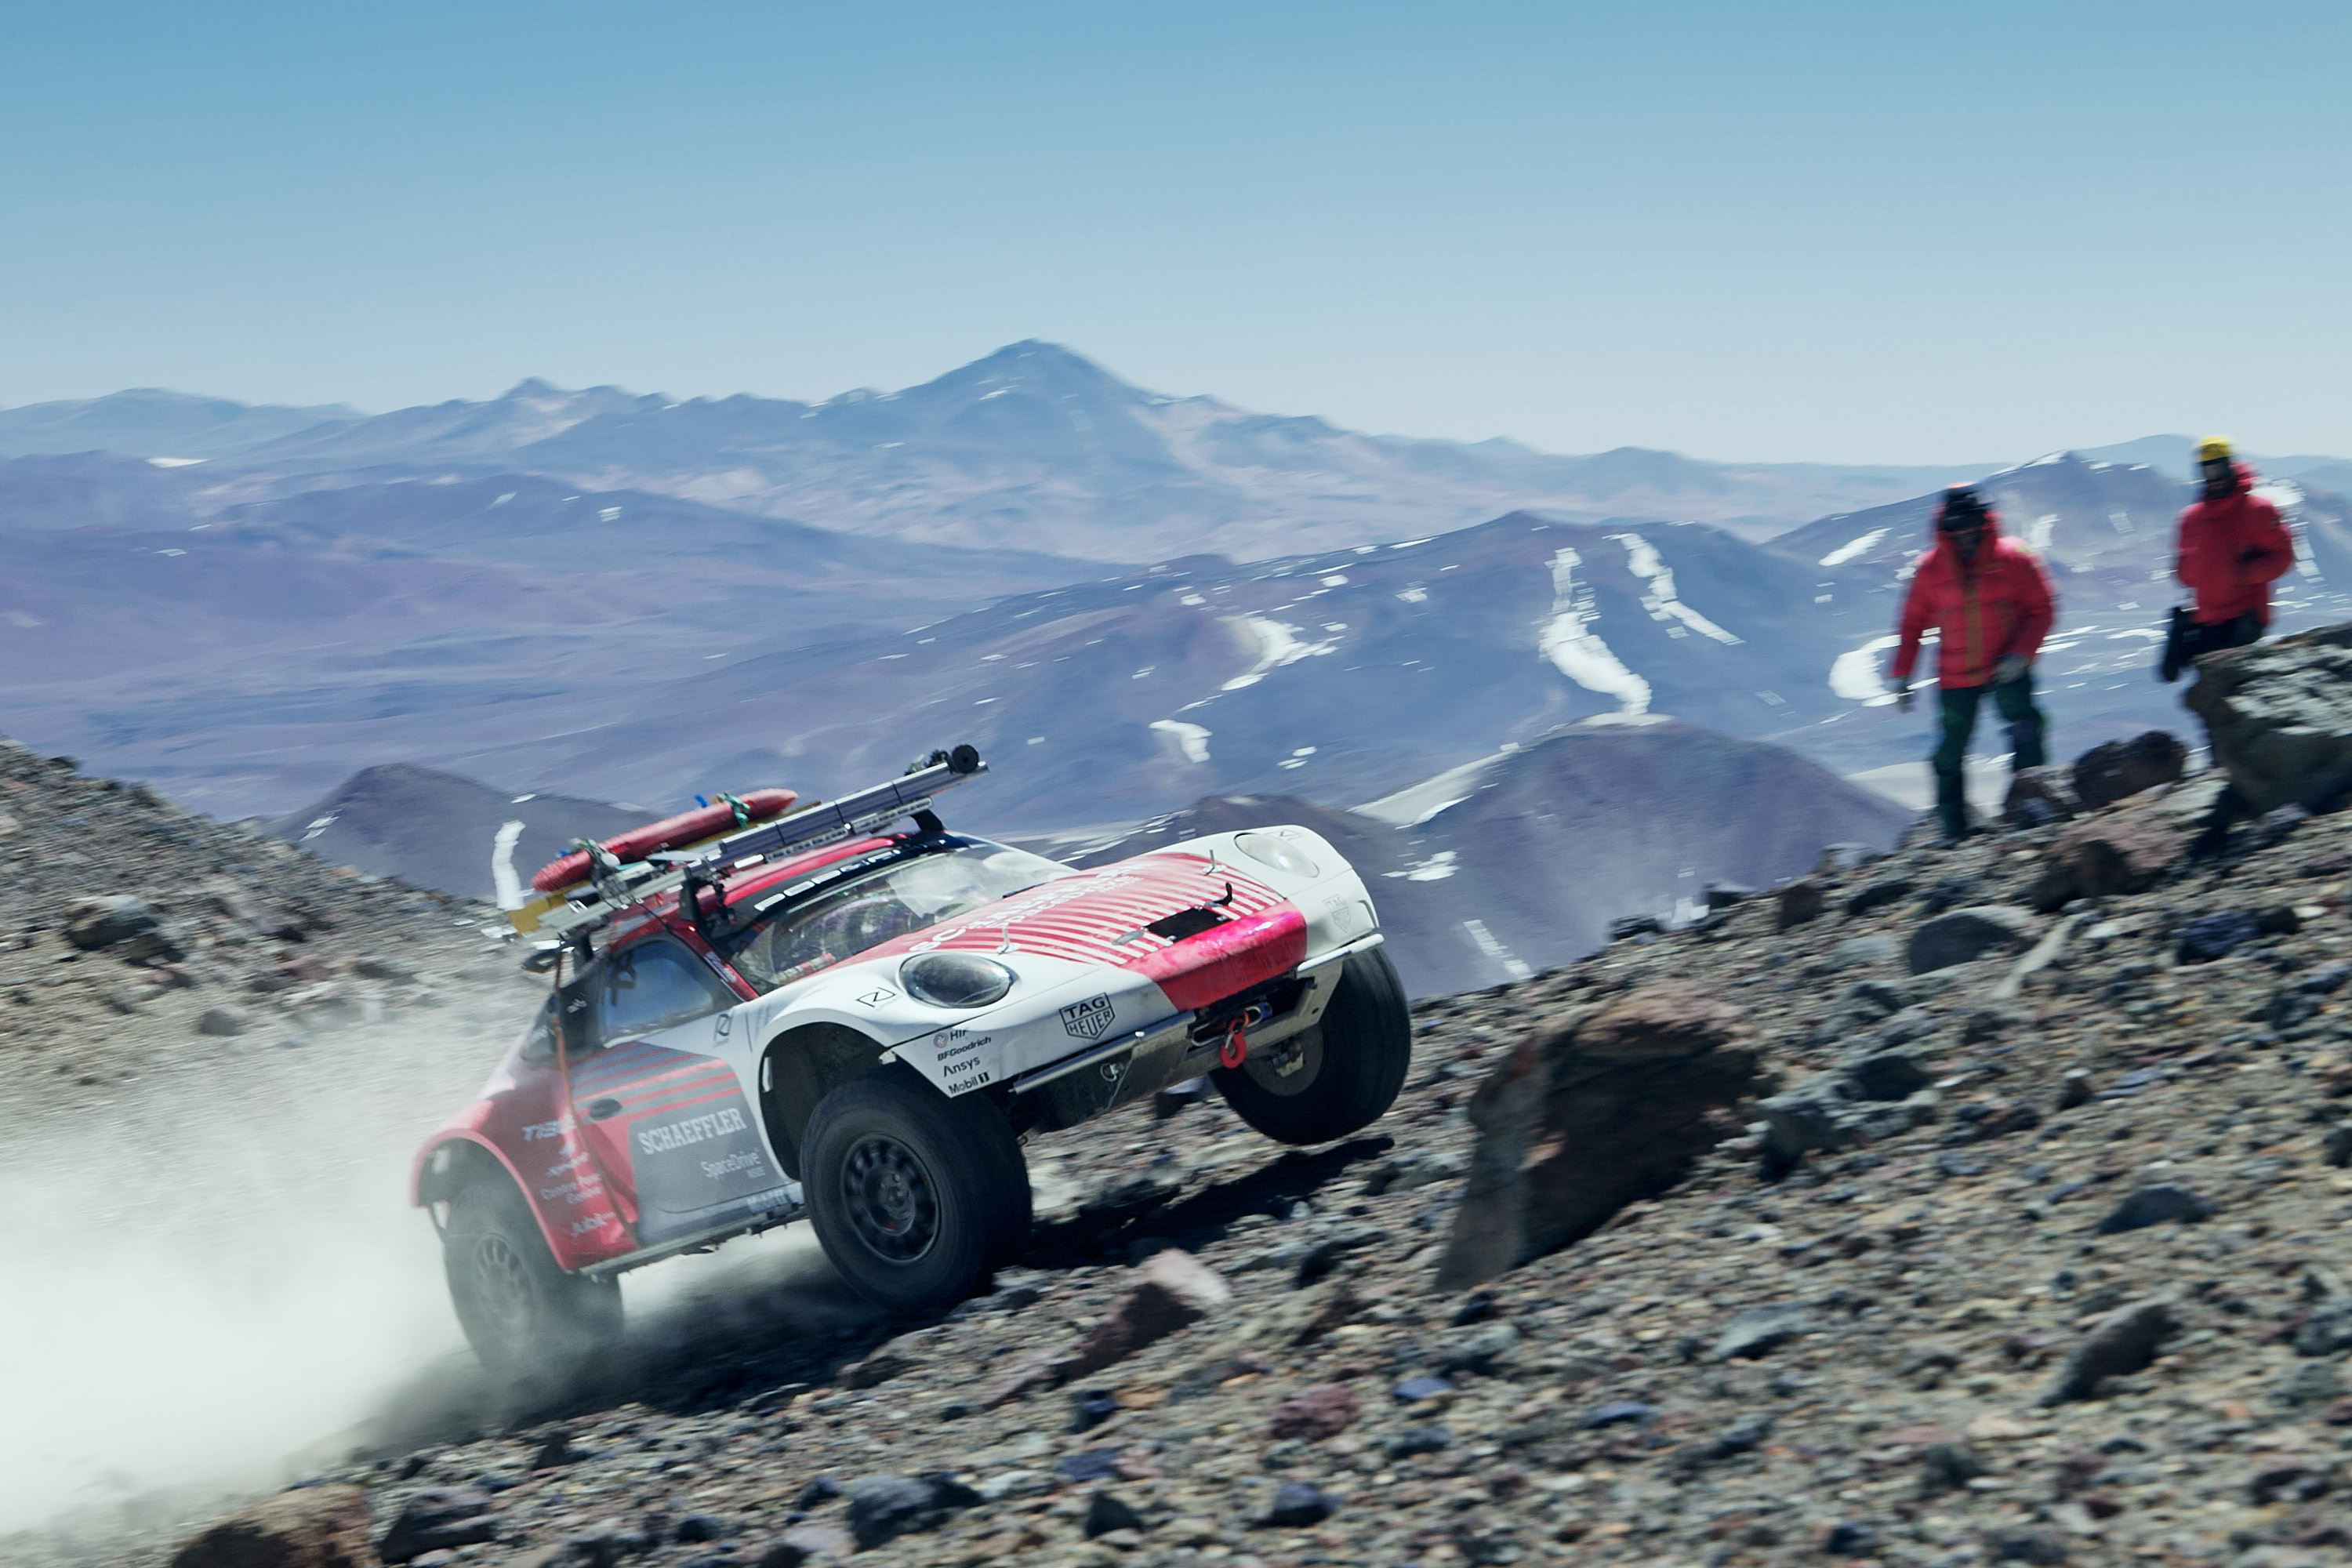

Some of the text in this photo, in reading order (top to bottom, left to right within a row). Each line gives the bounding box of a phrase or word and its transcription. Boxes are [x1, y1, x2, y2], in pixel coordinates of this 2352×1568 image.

[1064, 996, 1105, 1018] TAG
[1069, 1011, 1111, 1036] HEUER
[937, 1036, 992, 1062] BFGoodrich
[944, 1057, 981, 1077] Ansys
[948, 1076, 978, 1094] Mobil
[637, 1107, 747, 1156] SCHAEFFLER
[700, 1150, 761, 1180] SpaceDrive
